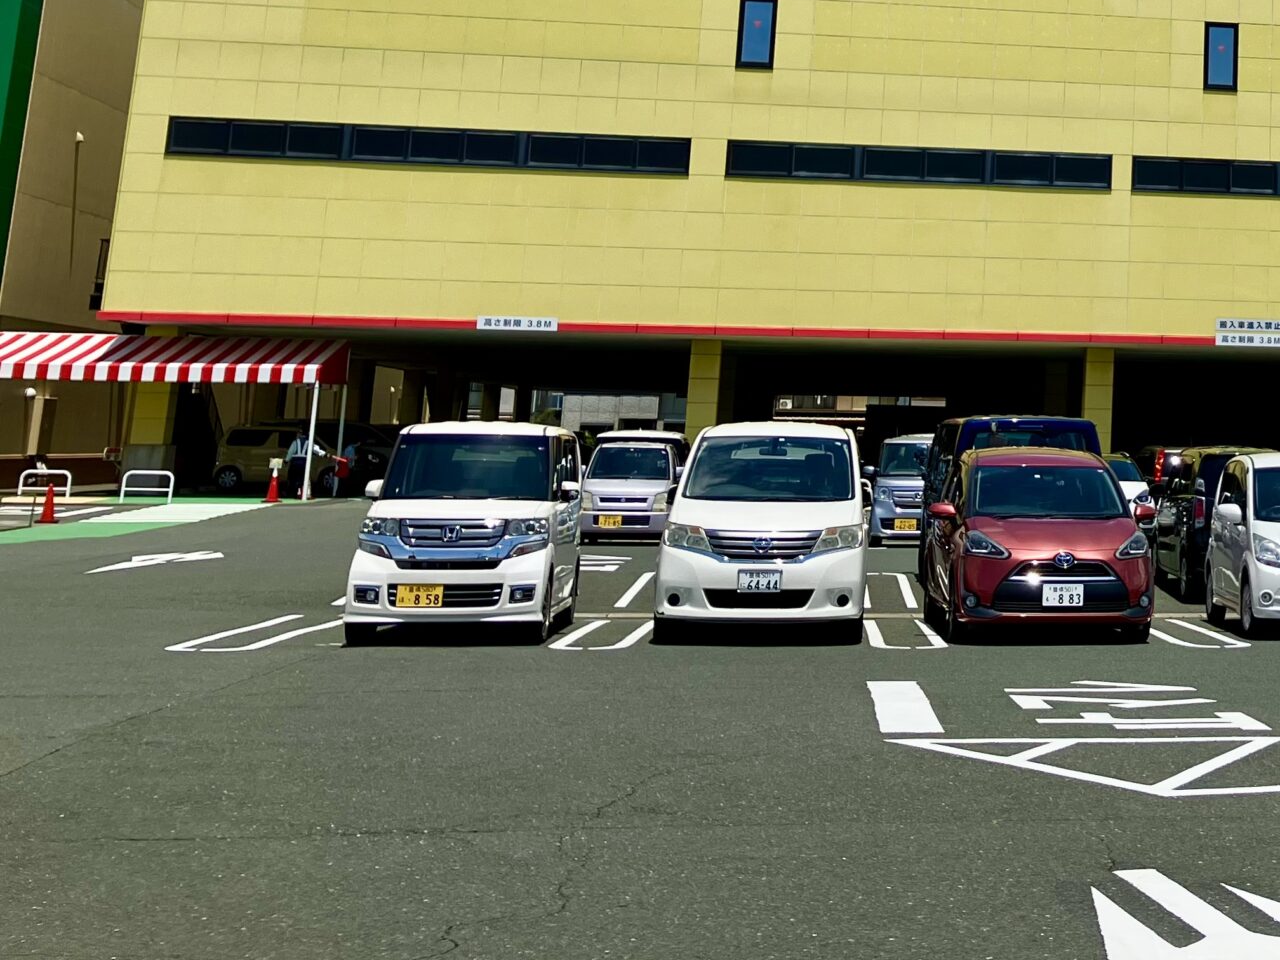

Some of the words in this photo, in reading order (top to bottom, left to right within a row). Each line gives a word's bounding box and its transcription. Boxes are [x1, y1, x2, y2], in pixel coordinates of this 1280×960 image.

[484, 318, 522, 328] 高さ制限
[1221, 335, 1254, 344] 高さ制限
[747, 579, 778, 591] 64-44
